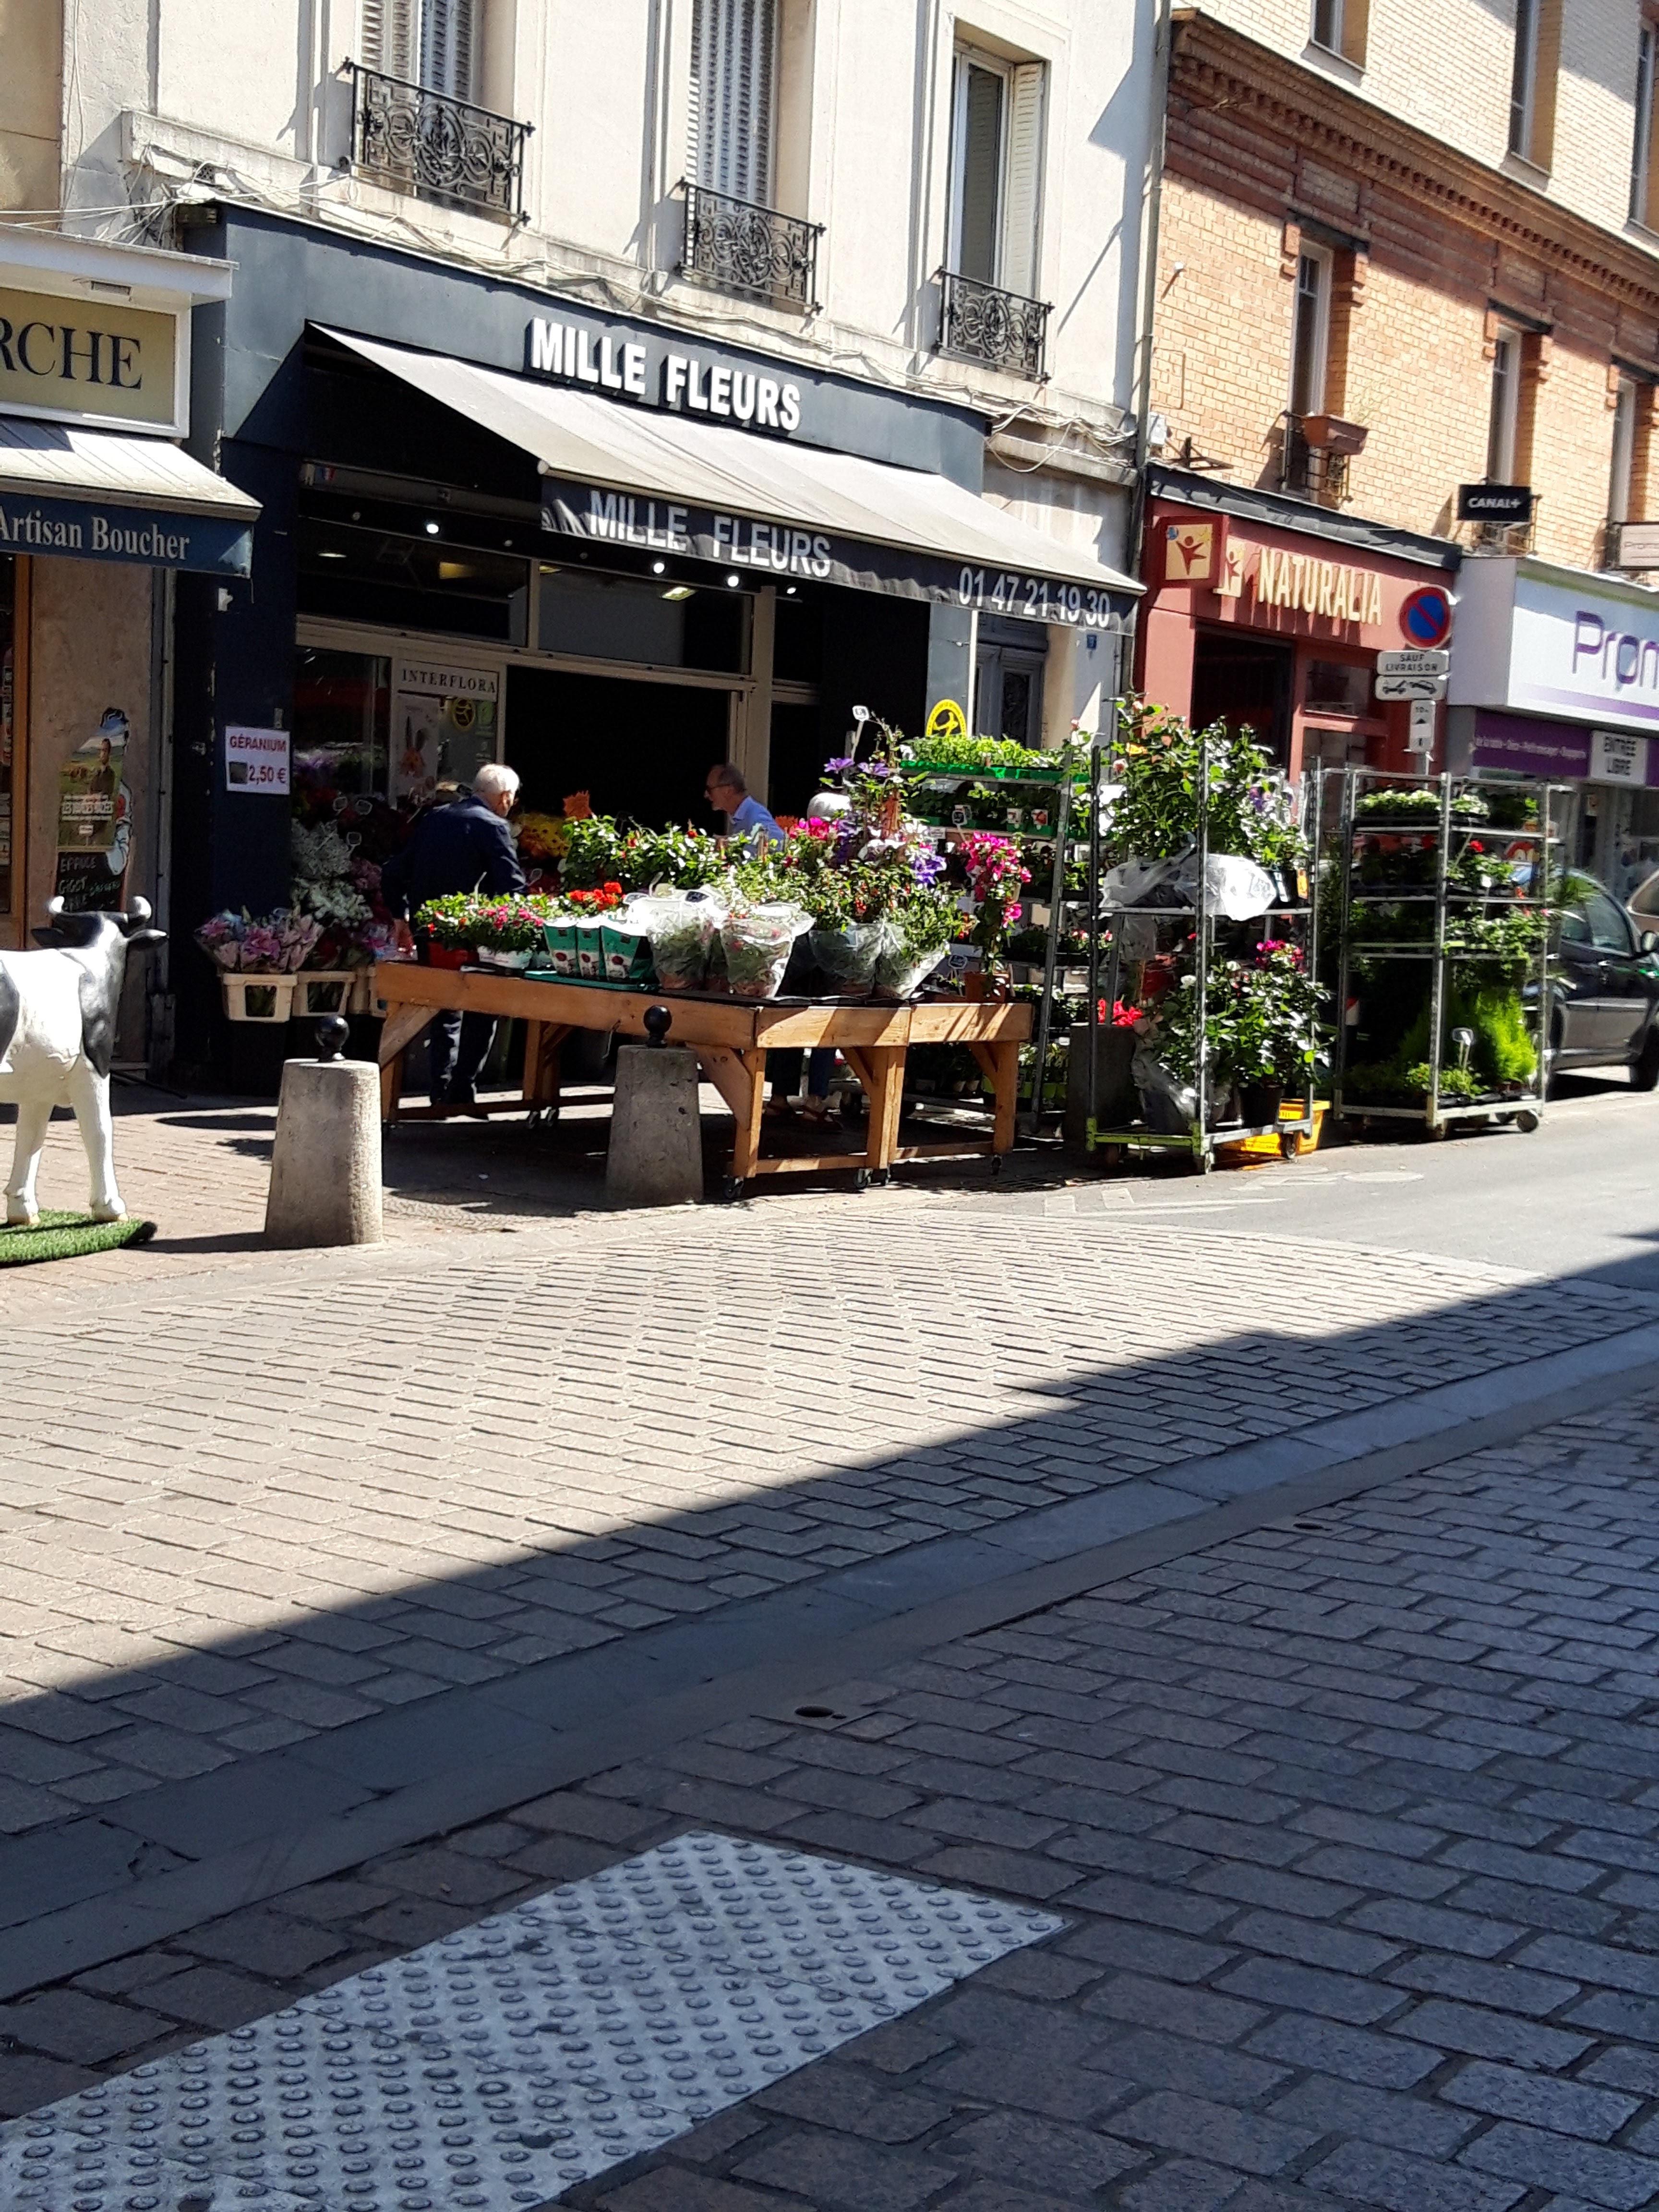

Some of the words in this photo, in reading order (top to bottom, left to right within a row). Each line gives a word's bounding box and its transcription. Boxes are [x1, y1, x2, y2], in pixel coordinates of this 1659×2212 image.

[531, 317, 647, 395] MILLE
[666, 354, 801, 431] FLEURS
[1468, 497, 1521, 509] CANAL+
[91, 517, 190, 560] Boucher
[590, 490, 688, 552] MILLE
[713, 515, 831, 577] FLEURS
[960, 567, 984, 606] 01
[991, 574, 1020, 612] 47
[1023, 579, 1048, 617] 21
[1058, 584, 1080, 622] 19
[1086, 590, 1110, 627] 30
[1258, 546, 1382, 625] NATURALIA
[1400, 654, 1425, 662] SAUF
[402, 669, 496, 693] INTERFLORA
[230, 733, 286, 752] GÉRANIUM
[249, 765, 274, 785] 2,50
[277, 768, 286, 783] €
